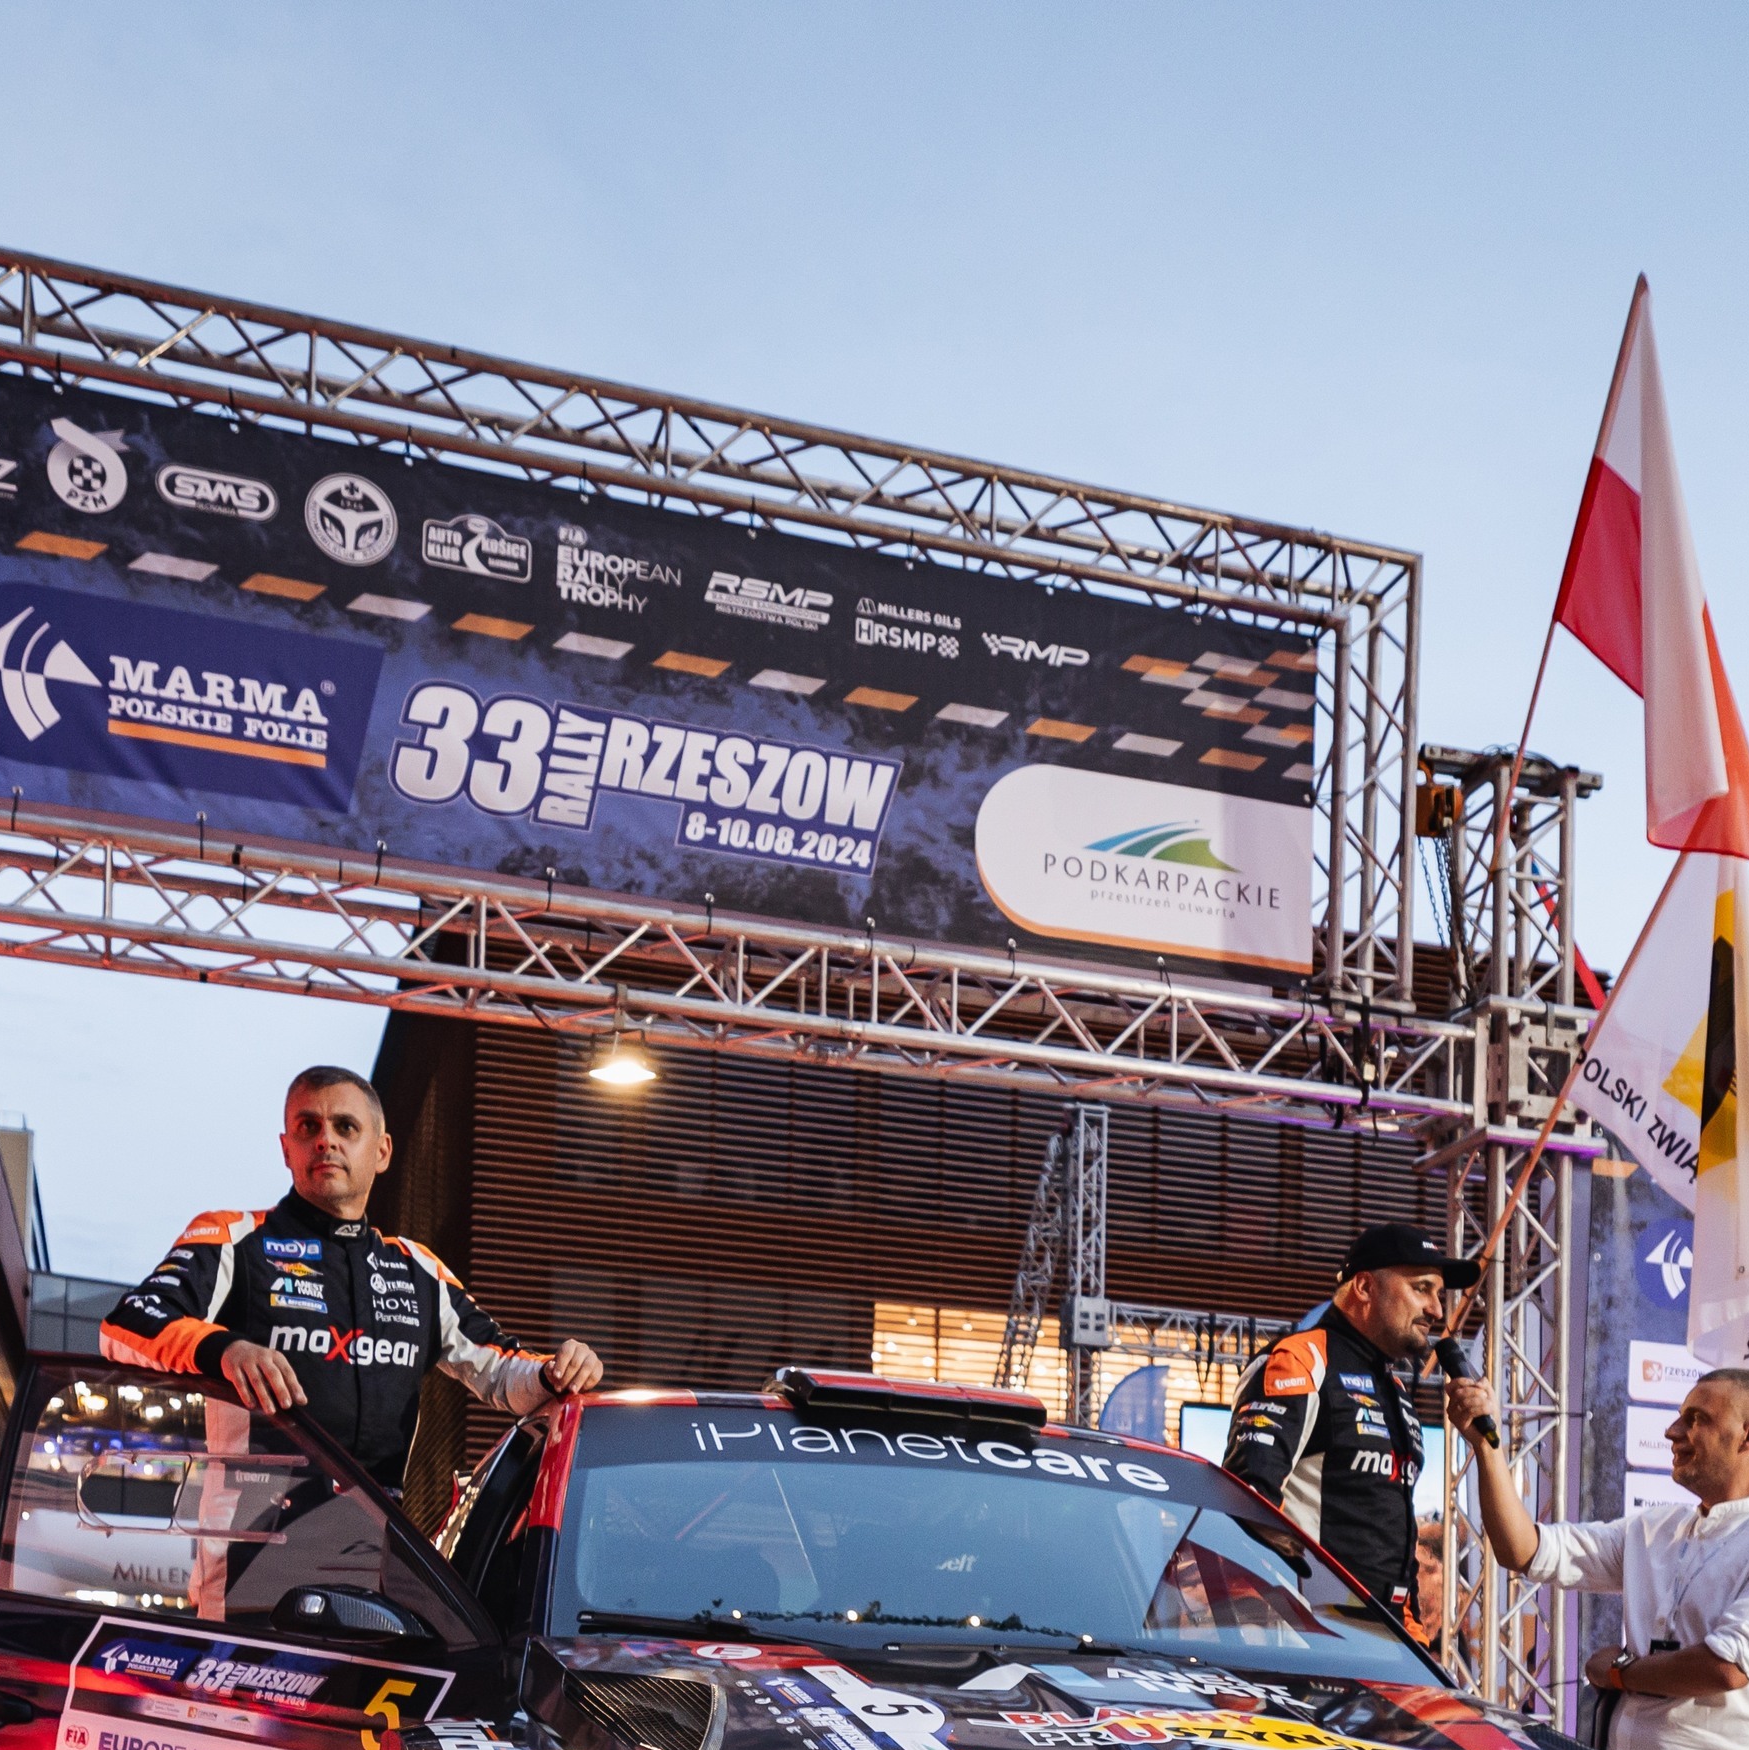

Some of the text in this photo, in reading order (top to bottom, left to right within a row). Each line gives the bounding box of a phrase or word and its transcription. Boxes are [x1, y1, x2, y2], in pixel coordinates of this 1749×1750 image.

[173, 474, 262, 511] SAMS
[428, 526, 462, 546] AUTO
[556, 562, 628, 594] RALLY
[557, 544, 682, 588] EUROPEAN
[556, 580, 649, 614] TROPHY
[705, 571, 834, 608] RSMP
[877, 602, 962, 631] MILLERS OILS
[1000, 635, 1090, 667] RMP
[108, 655, 328, 725] MARMA
[107, 694, 328, 750] POLSKIE FOLIE
[394, 685, 895, 832] 33 RALLY RZESZOW
[684, 811, 874, 870] 8-10.08.2024
[1044, 853, 1281, 910] PODKARPACKIE
[1090, 887, 1237, 920] przestrzeń otwarta
[1647, 1113, 1700, 1186] ZWIĄ
[265, 1240, 320, 1258] moya
[690, 1421, 1170, 1493] iPlanetcare
[112, 1561, 191, 1582] MILLEN
[130, 1652, 178, 1671] MARMA
[185, 1658, 231, 1693] 33
[240, 1664, 324, 1696] RZESZOW
